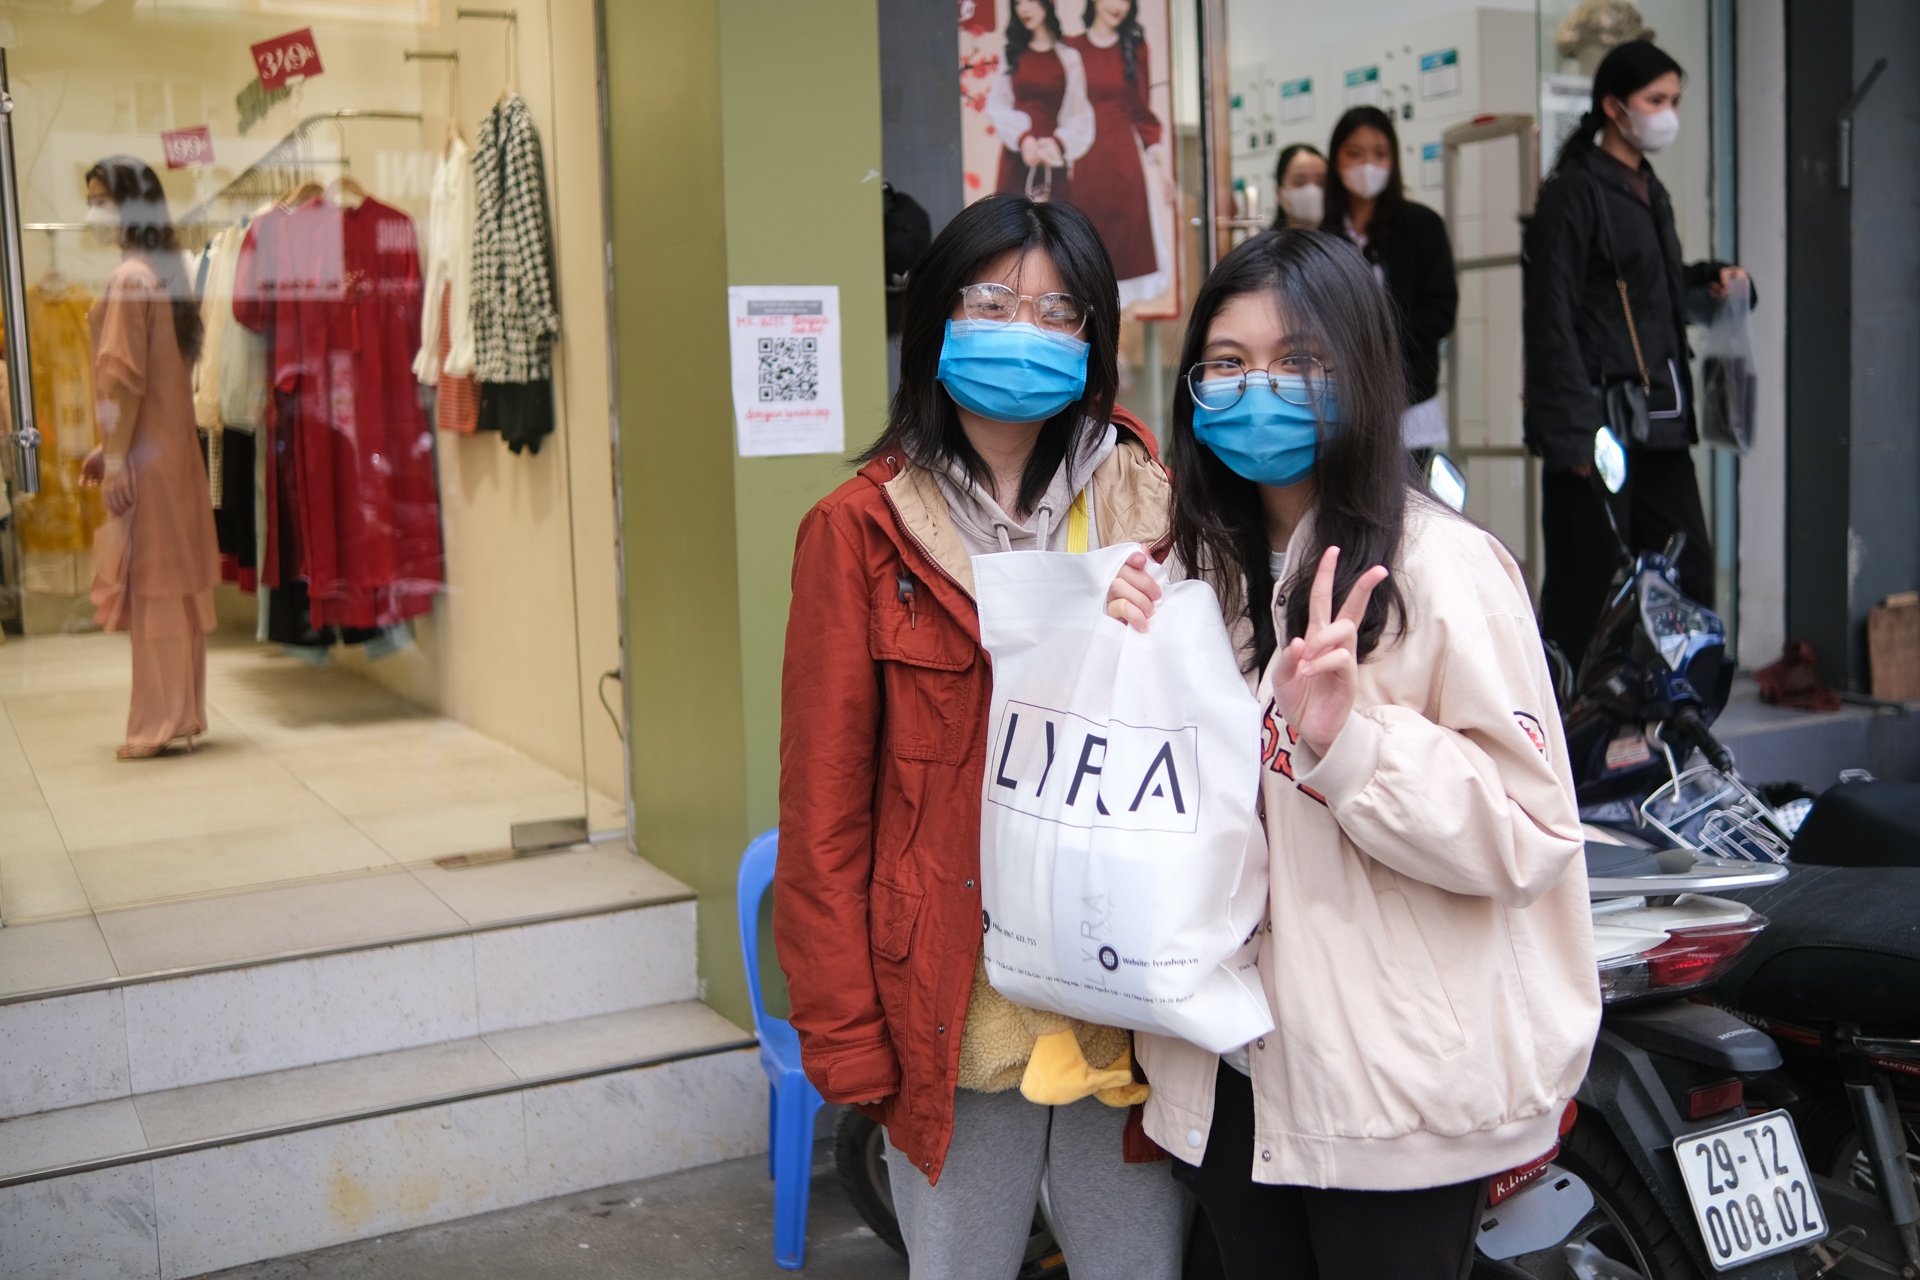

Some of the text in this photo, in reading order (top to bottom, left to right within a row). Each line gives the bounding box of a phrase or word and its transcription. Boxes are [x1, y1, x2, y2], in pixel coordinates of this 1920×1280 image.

[996, 712, 1186, 816] LYRA
[1122, 957, 1199, 968] Website: lyrashop.vn
[1695, 1125, 1789, 1196] 29-T2
[1705, 1180, 1818, 1258] 008.02
